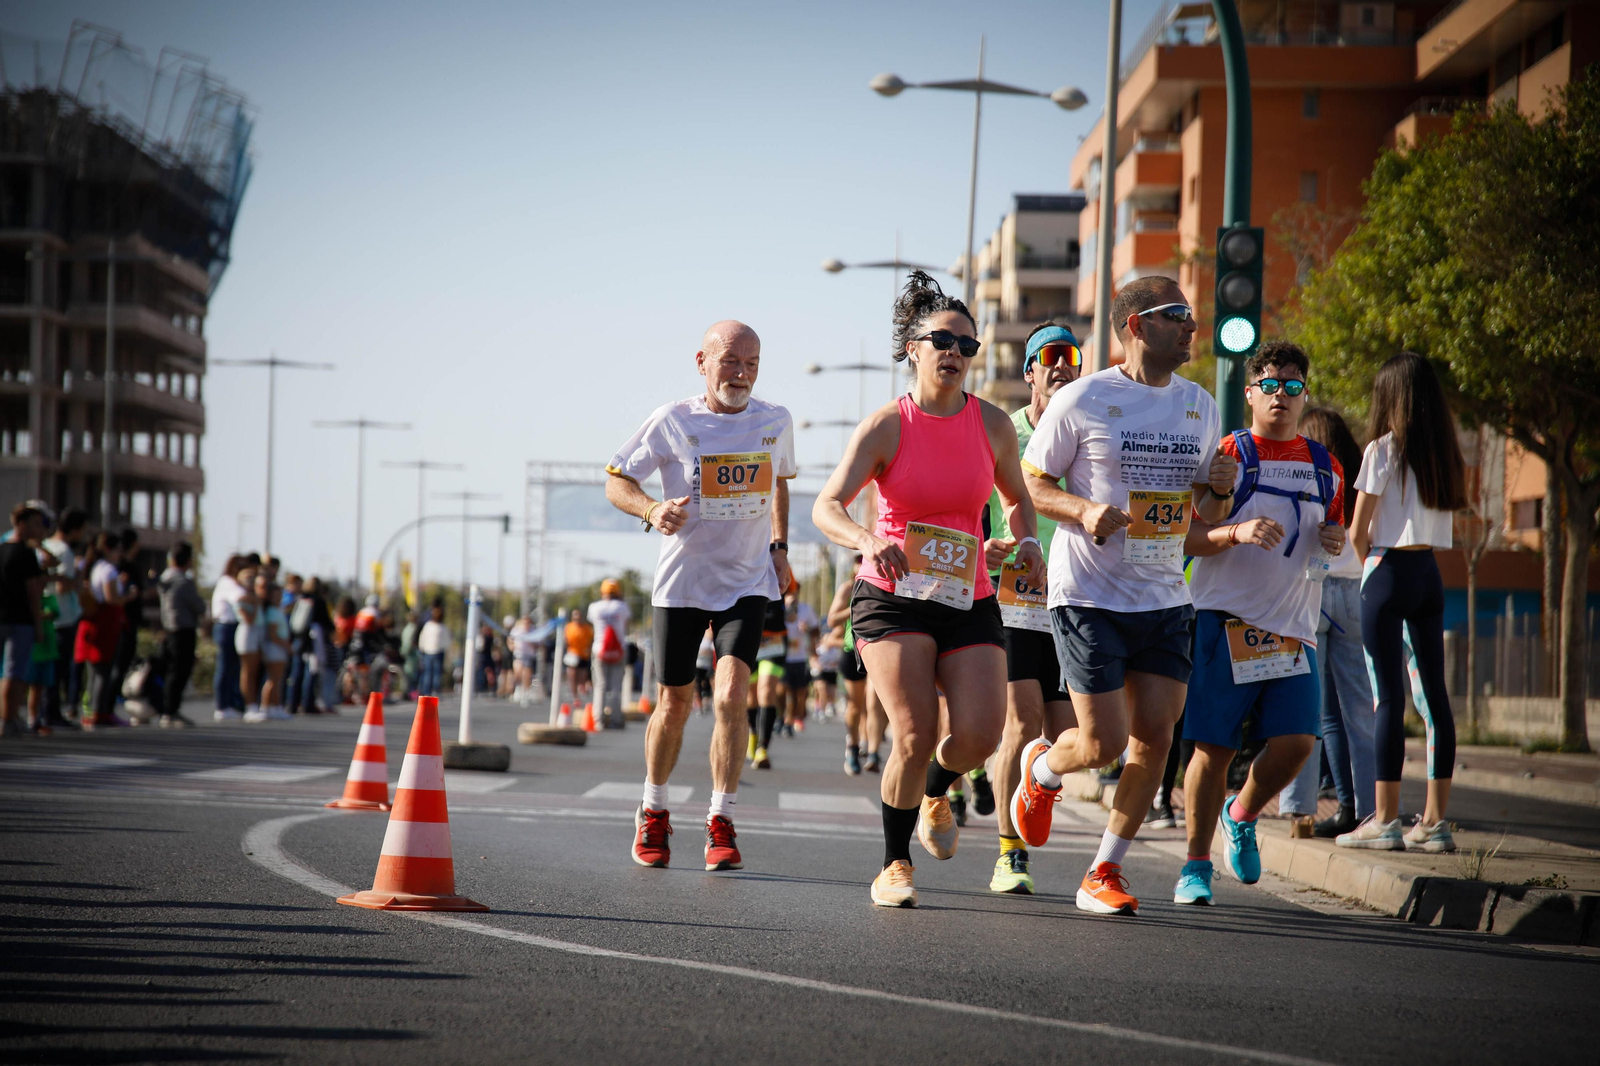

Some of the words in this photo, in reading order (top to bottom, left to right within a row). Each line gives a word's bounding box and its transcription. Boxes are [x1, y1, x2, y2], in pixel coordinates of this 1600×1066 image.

[1121, 430, 1155, 440] Medio
[1159, 432, 1200, 443] Maratón
[1121, 440, 1168, 454] Almería
[1171, 443, 1201, 455] 2024
[1121, 455, 1148, 463] RAMÓN
[716, 464, 760, 485] 807
[1144, 503, 1184, 525] 434
[920, 539, 968, 568] 432
[932, 562, 953, 572] CRISTI
[1015, 575, 1048, 596] 62
